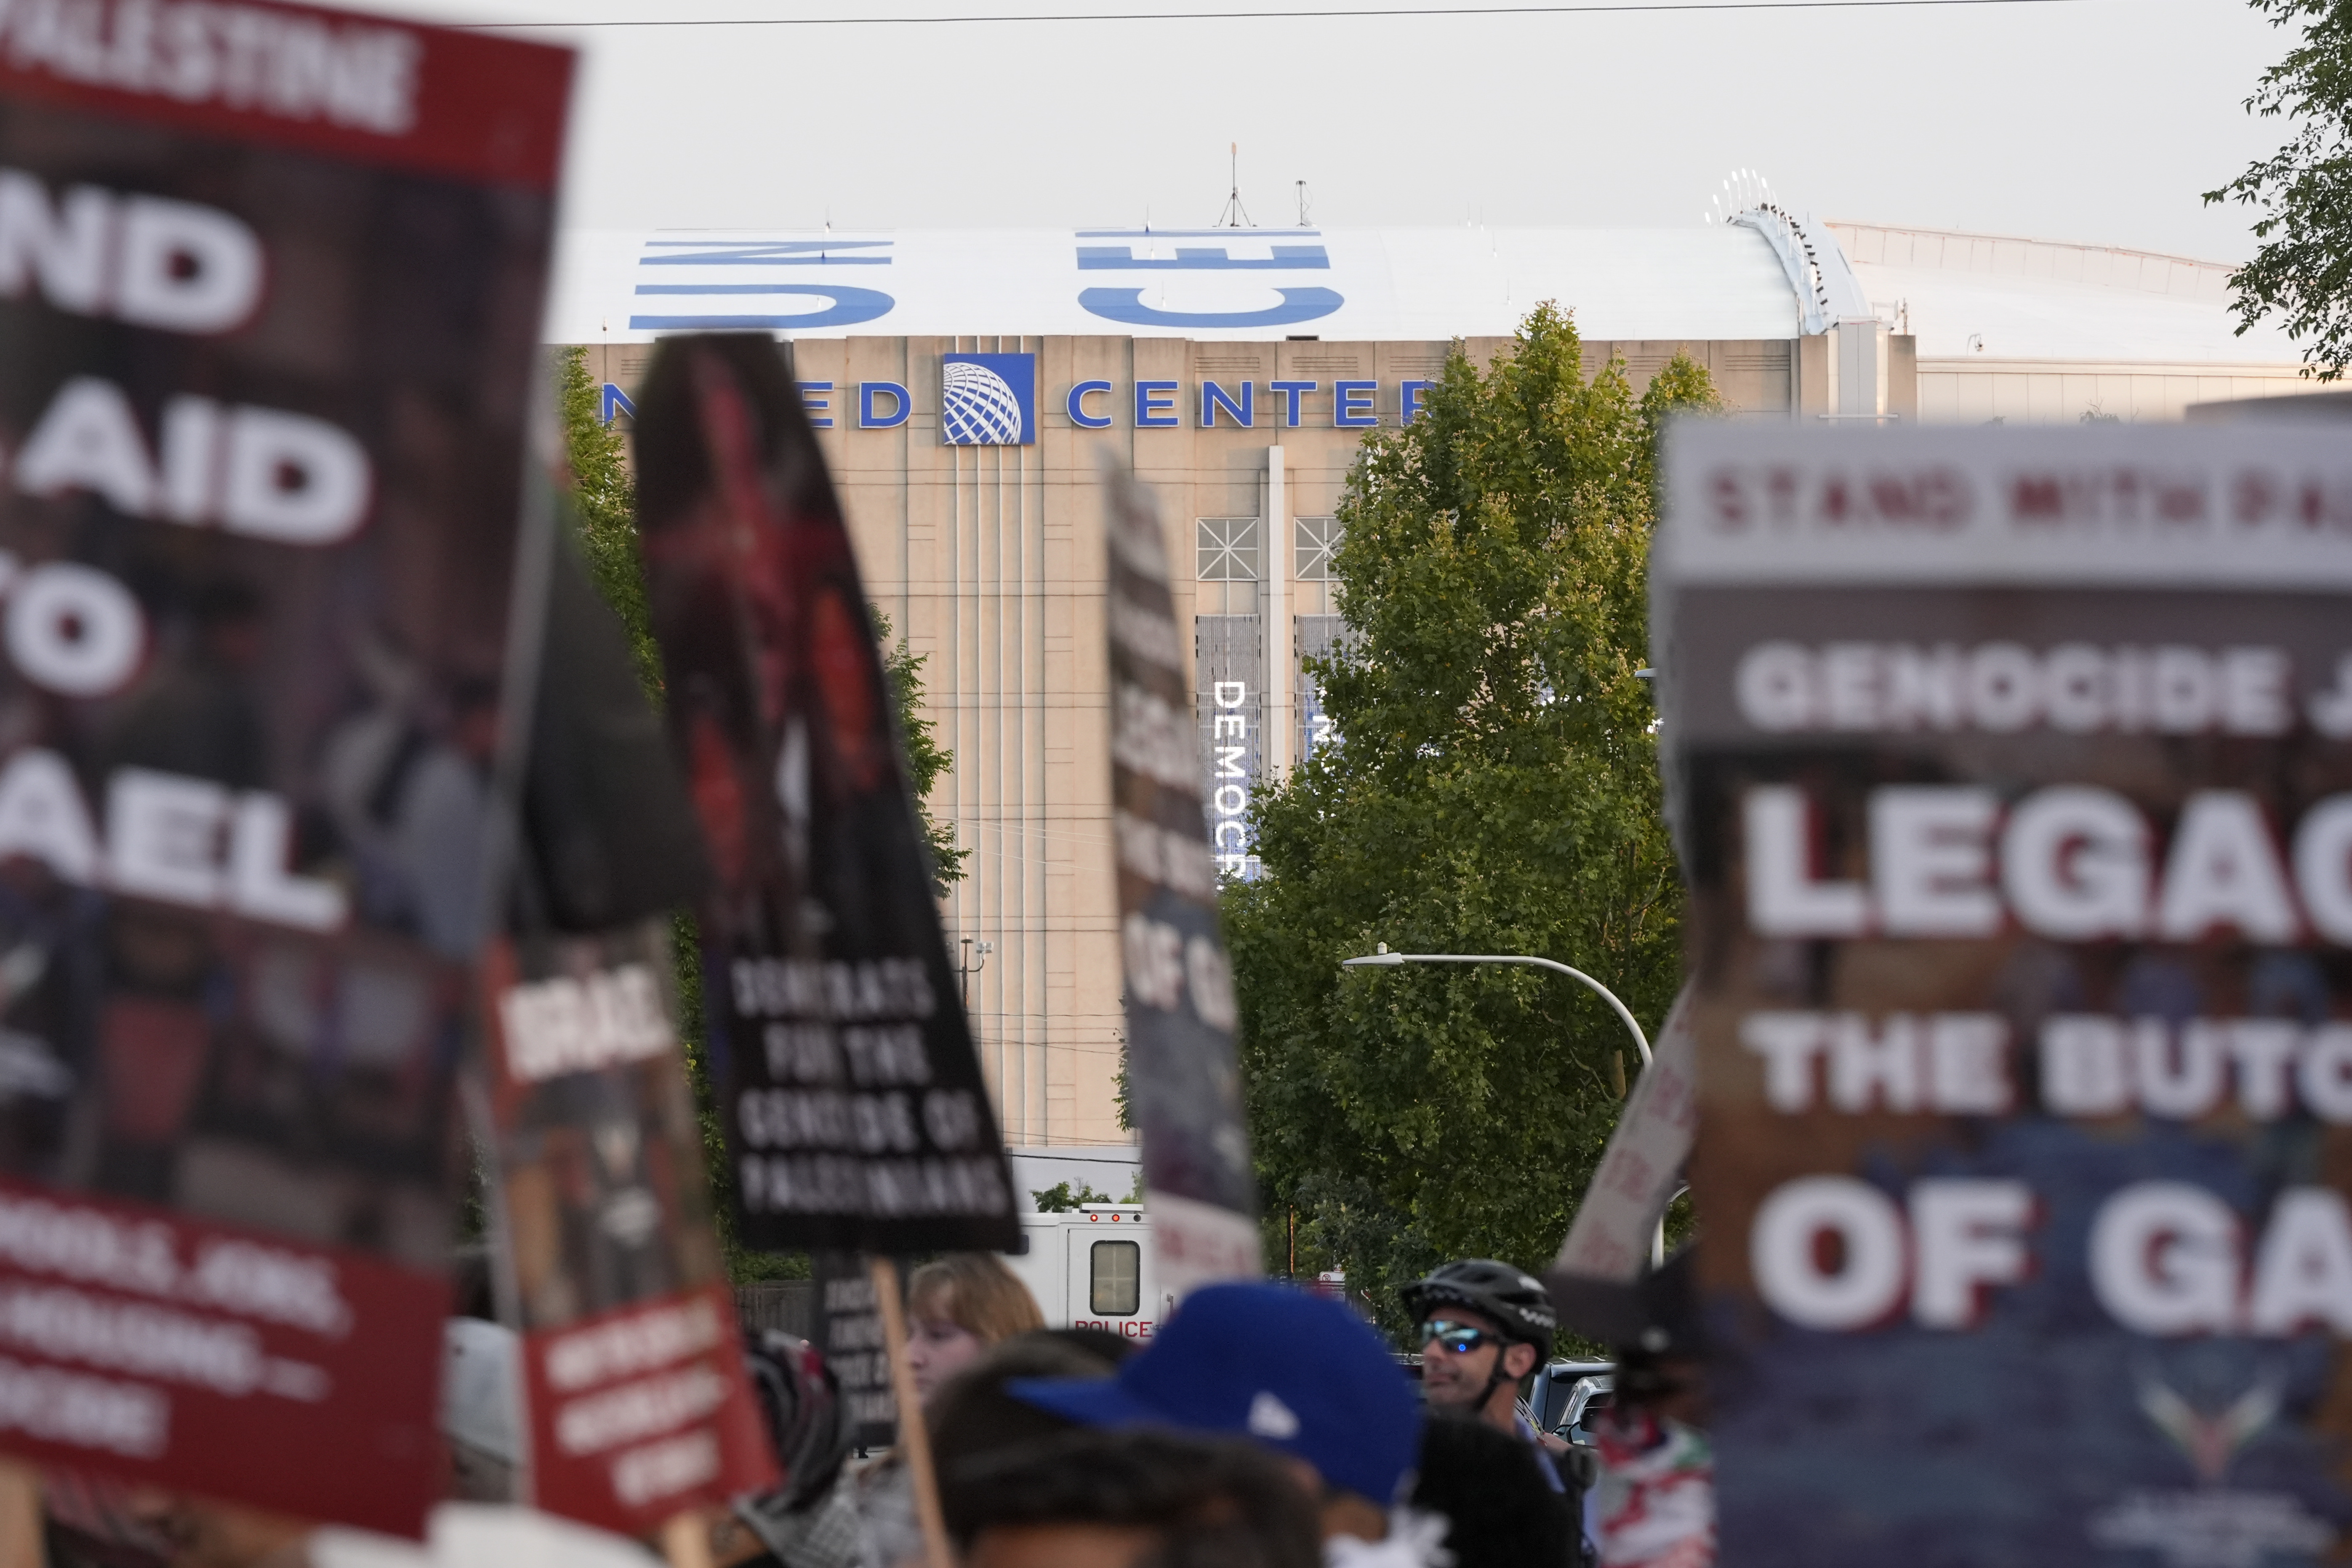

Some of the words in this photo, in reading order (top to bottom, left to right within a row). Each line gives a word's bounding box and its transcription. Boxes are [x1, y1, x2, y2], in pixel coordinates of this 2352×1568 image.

[1075, 232, 1345, 327] CE
[1067, 380, 1442, 429] CENTER
[17, 376, 372, 544] AID
[1707, 469, 1970, 532] STAND
[2007, 469, 2206, 531] WITH
[2232, 471, 2352, 531] PA
[0, 551, 145, 695] O
[1735, 642, 2290, 736] GENOCIDE
[1215, 681, 1246, 890] DEMOCR
[1742, 1012, 2014, 1113] THE
[1750, 1174, 2032, 1331] OF
